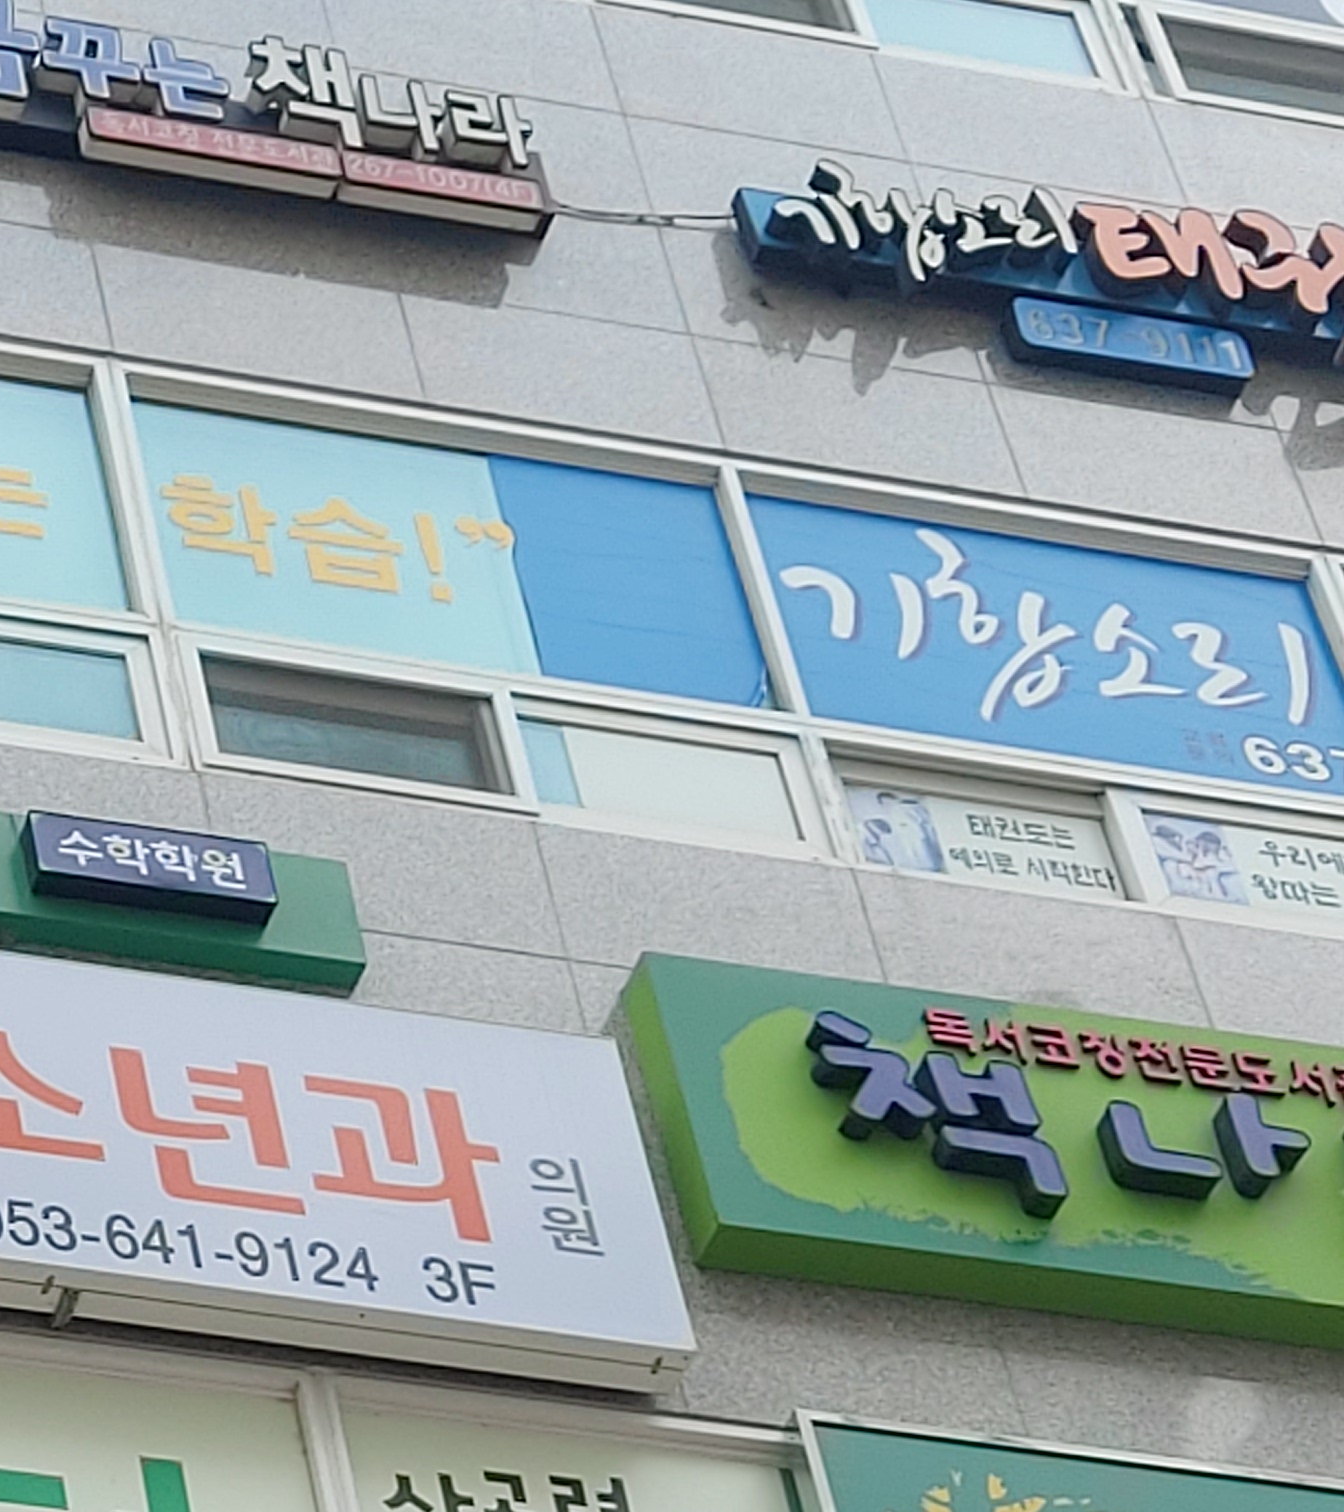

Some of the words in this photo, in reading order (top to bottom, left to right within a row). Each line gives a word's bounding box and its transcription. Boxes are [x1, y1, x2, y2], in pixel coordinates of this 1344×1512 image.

[249, 35, 534, 167] 책나라
[1242, 735, 1344, 782] 63
[58, 828, 247, 889] 수학학원
[808, 1010, 1344, 1200] 책나
[530, 1157, 606, 1258] 의원
[422, 1256, 497, 1307] 3F
